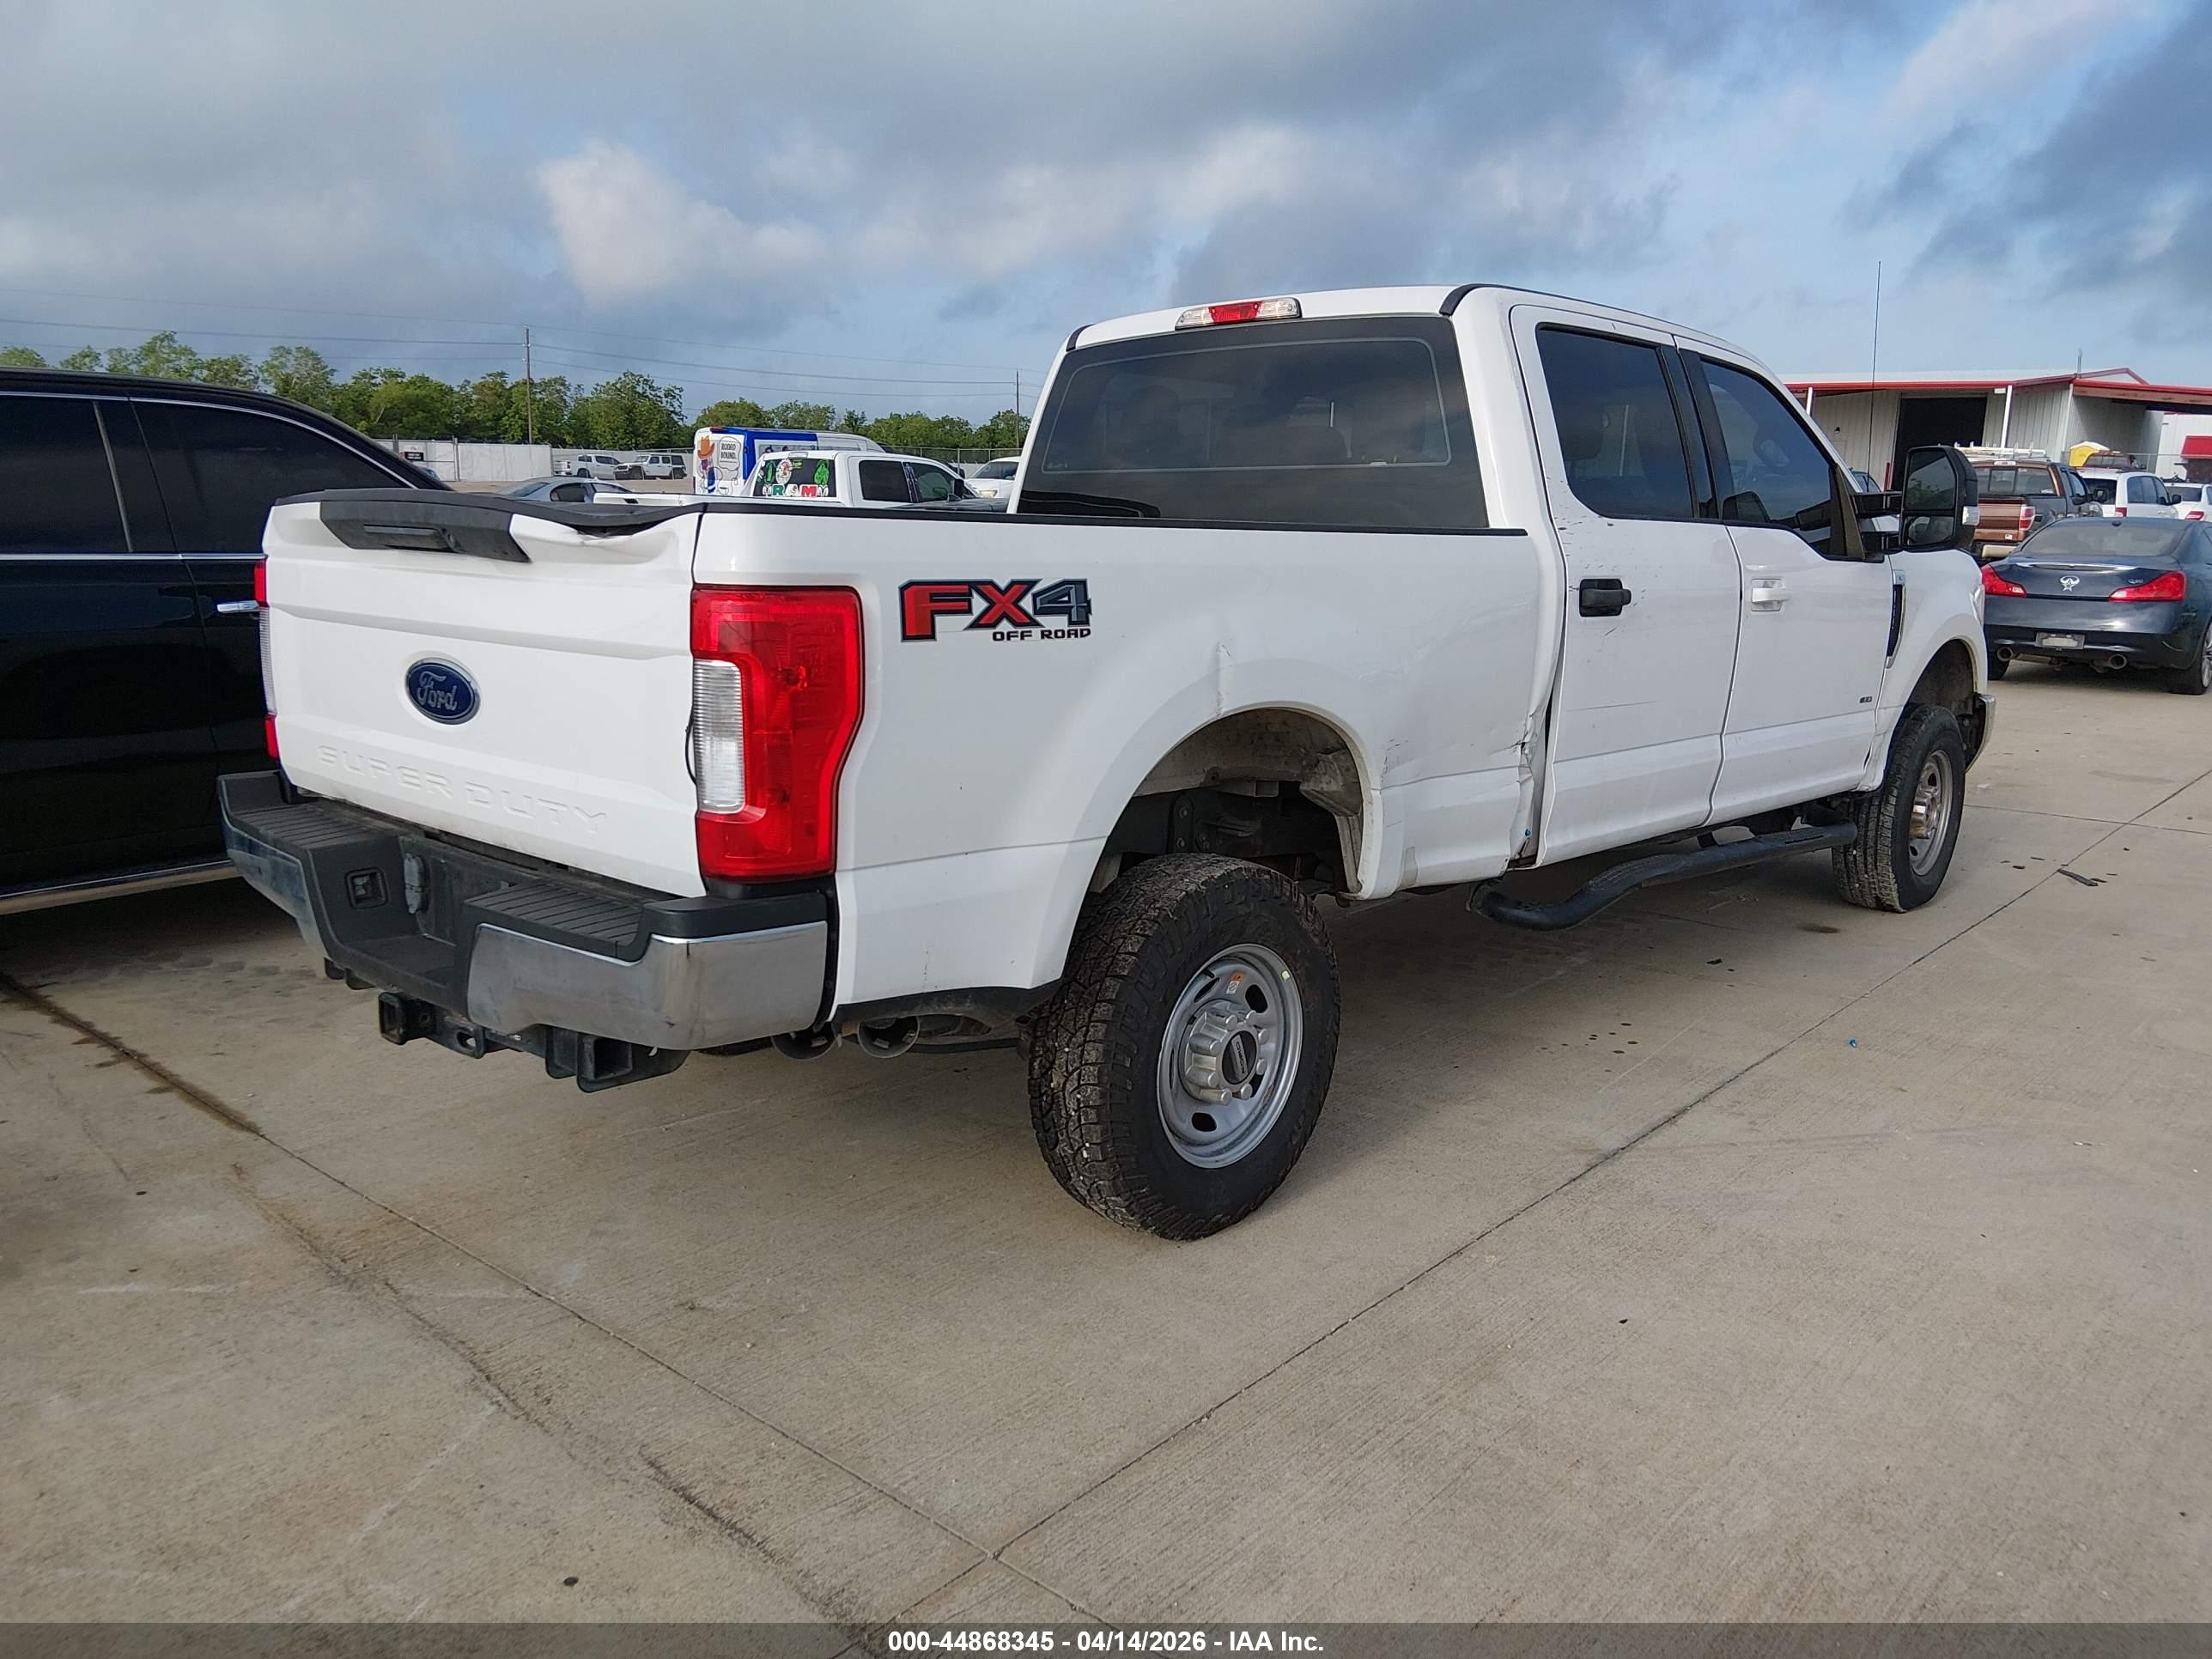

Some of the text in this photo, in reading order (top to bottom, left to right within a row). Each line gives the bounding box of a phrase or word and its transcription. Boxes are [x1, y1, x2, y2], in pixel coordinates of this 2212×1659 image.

[898, 579, 1092, 642] FX4
[992, 628, 1091, 641] OFF ROAD
[416, 671, 459, 713] Ford
[317, 744, 607, 835] SUPER DUTY
